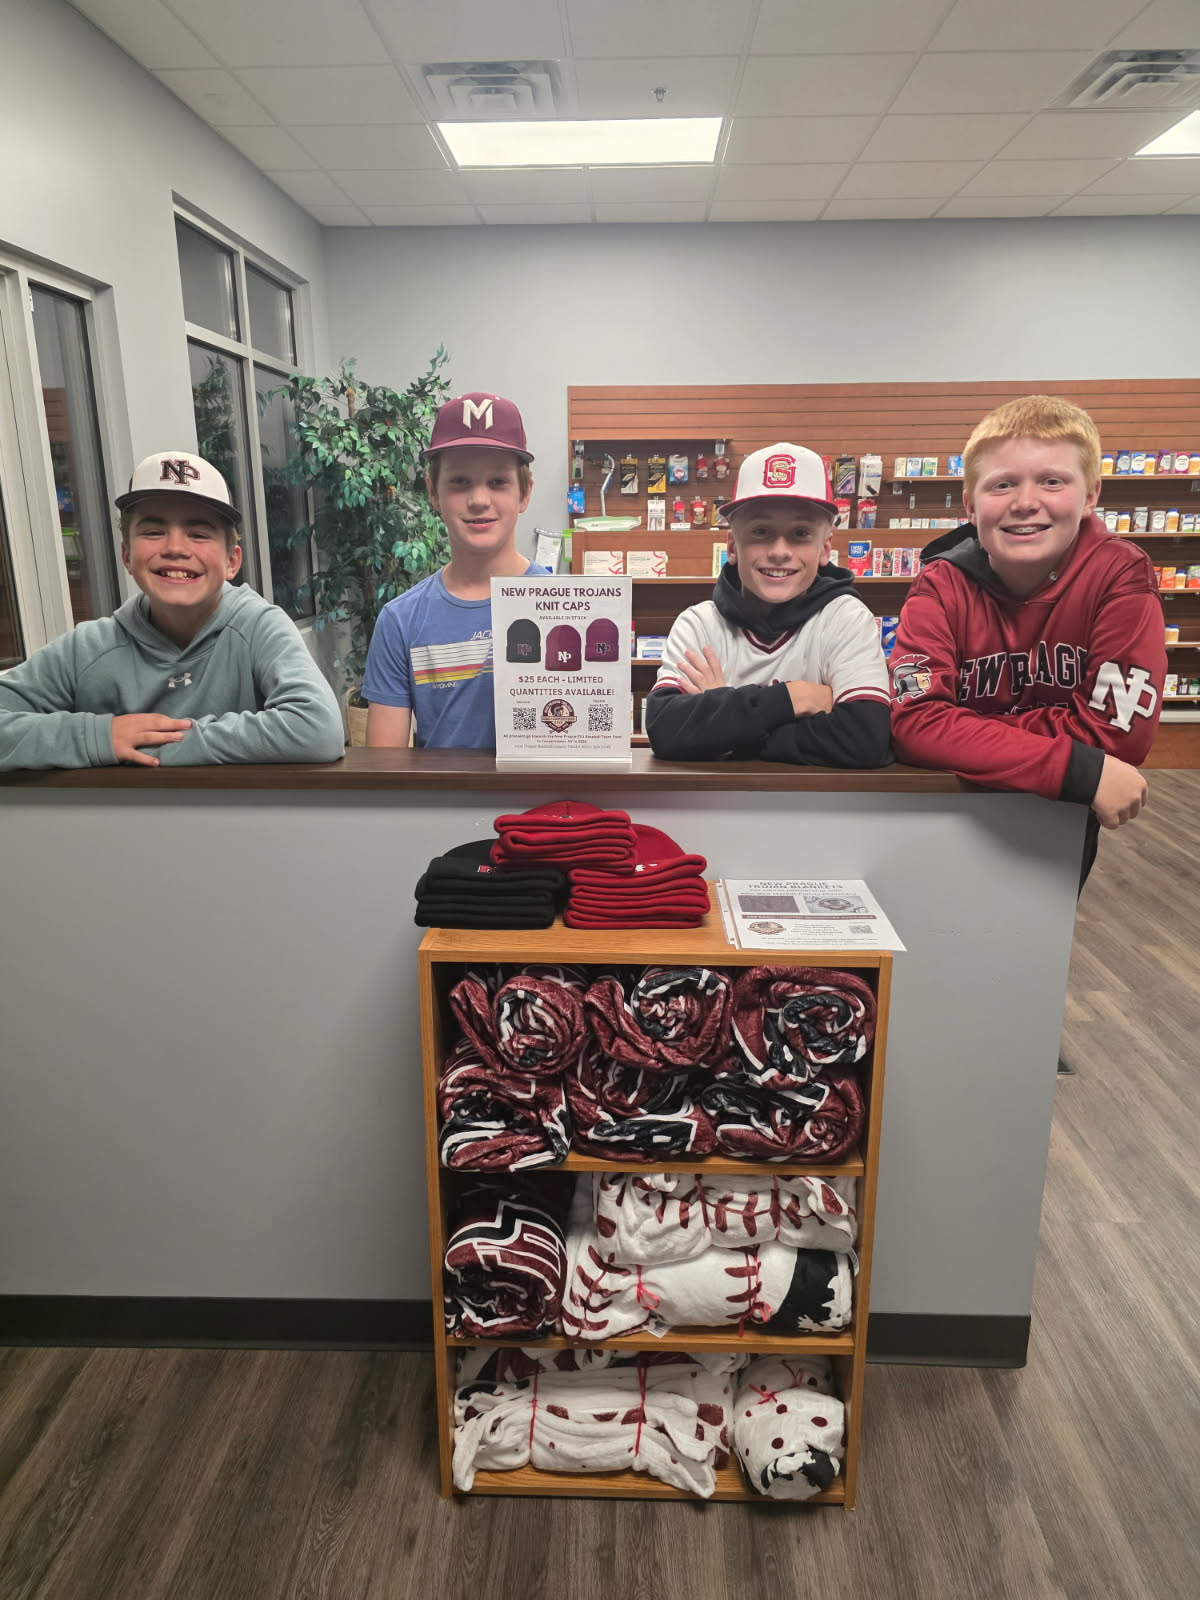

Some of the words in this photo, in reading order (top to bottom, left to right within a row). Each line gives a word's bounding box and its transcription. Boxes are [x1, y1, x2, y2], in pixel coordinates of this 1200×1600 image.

[462, 399, 494, 430] M
[160, 459, 201, 486] NP
[501, 587, 526, 597] NEW
[528, 587, 571, 597] PRAGUE
[573, 587, 622, 597] TROJANS
[535, 601, 560, 611] KNIT
[562, 601, 591, 611] CAPS
[958, 652, 1007, 701] EW
[1009, 640, 1088, 696] RAG
[510, 688, 563, 696] QUANTITIES
[565, 688, 615, 696] AVAILABLE!
[1087, 660, 1159, 734] NP
